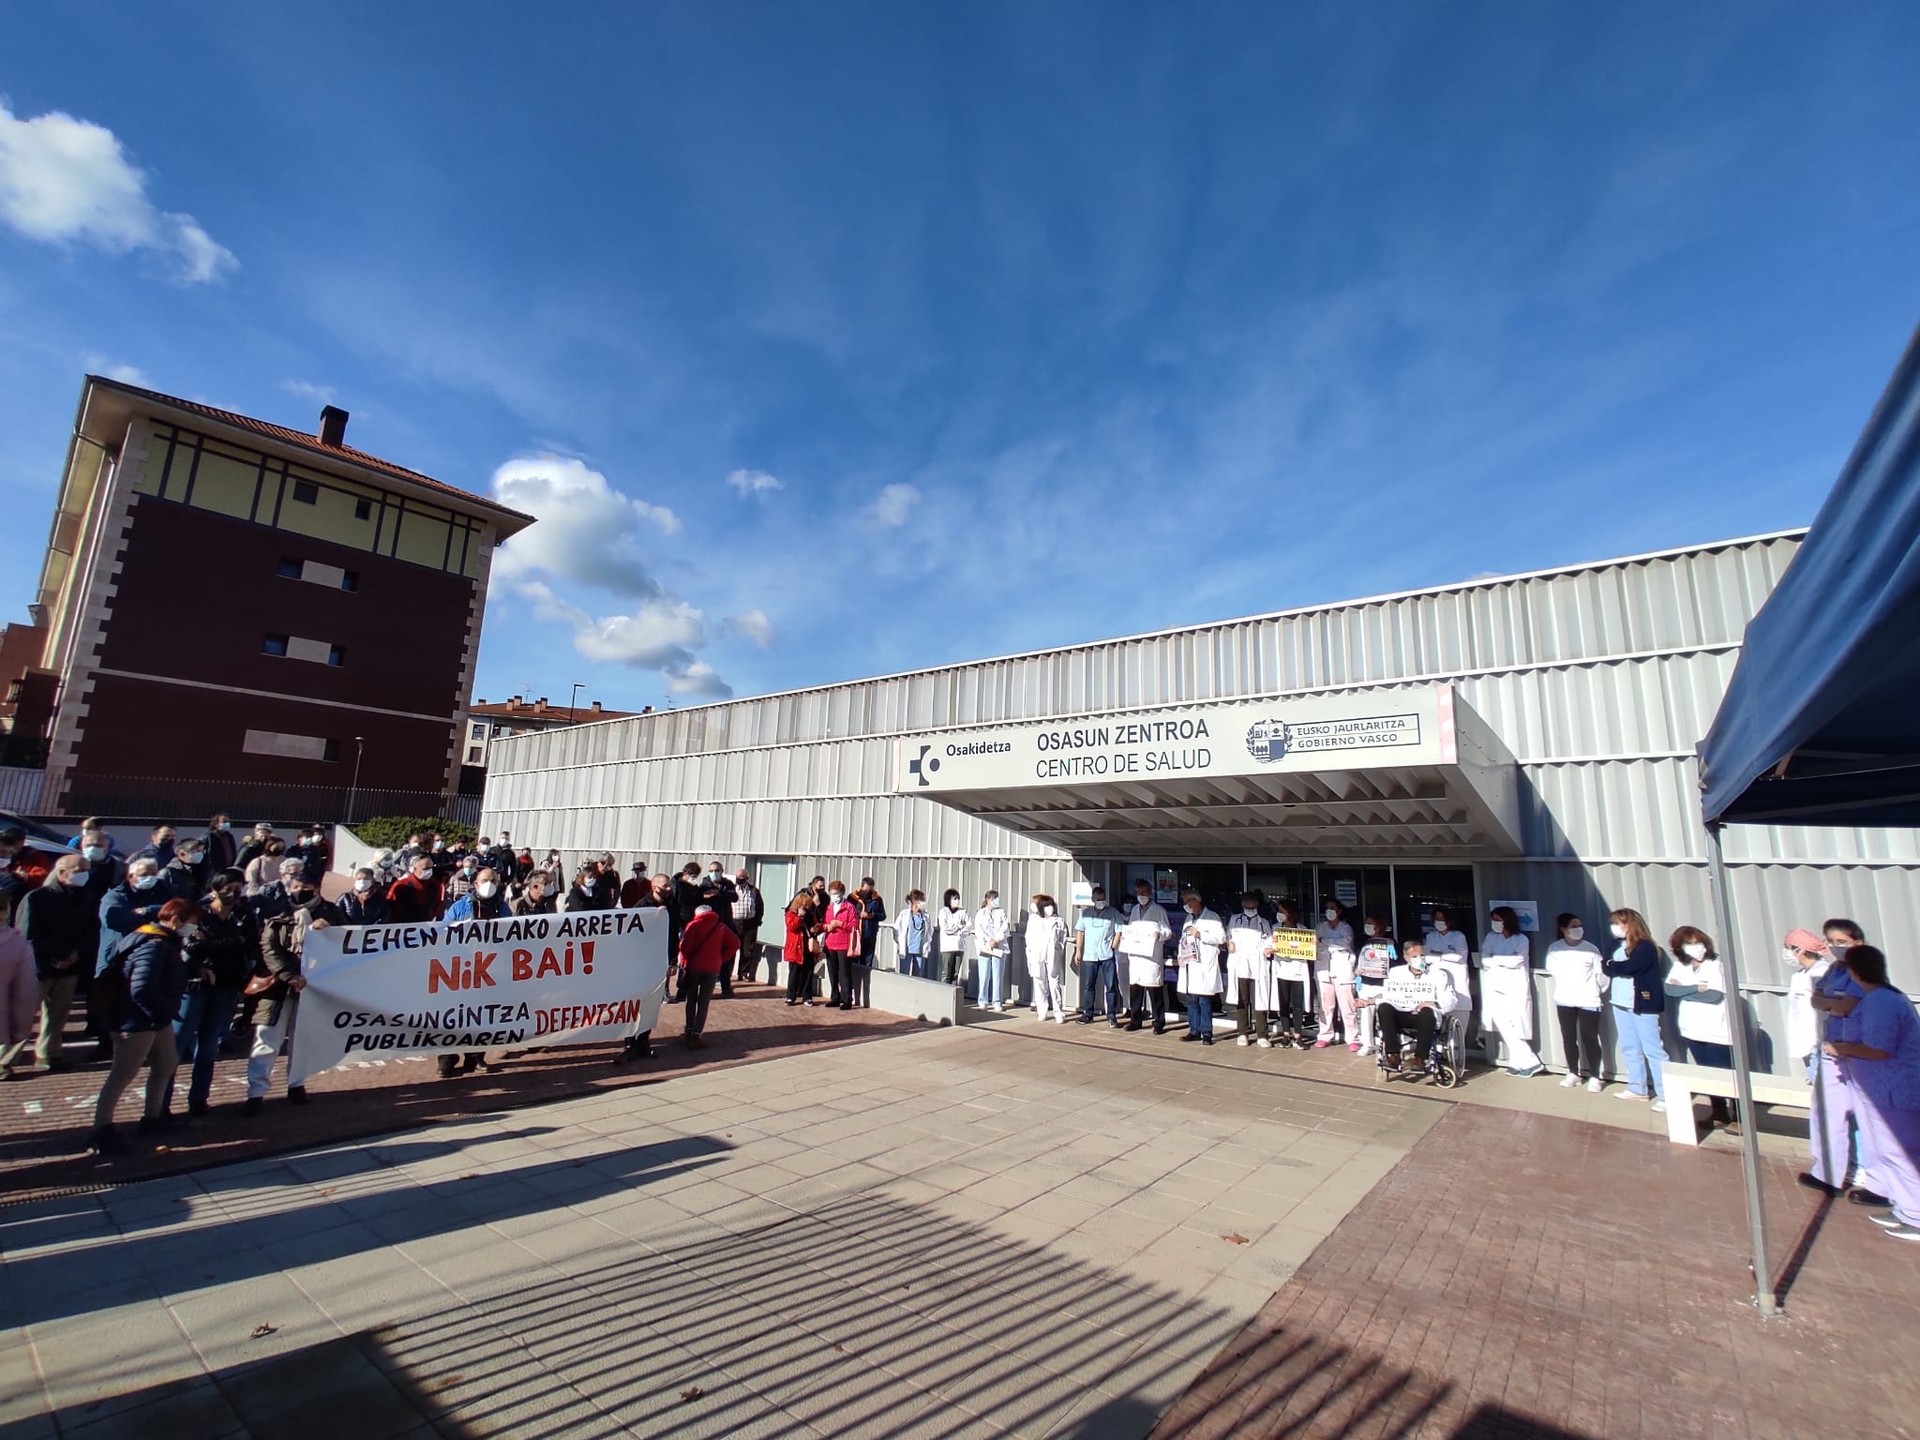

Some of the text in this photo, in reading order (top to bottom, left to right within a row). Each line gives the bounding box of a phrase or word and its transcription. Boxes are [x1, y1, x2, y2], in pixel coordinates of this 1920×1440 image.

[1037, 718, 1210, 751] OSASUN ZENTROA
[1297, 719, 1406, 736] EUSKO JAURLARITZA
[946, 741, 1012, 757] Osakidetza
[1298, 733, 1398, 748] GOBIERNO VASCO
[1036, 748, 1211, 778] CENTRO DE SALUD
[342, 913, 645, 955] LEHEN MAILAKO ARRETA
[1399, 986, 1433, 994] PELIGRO
[534, 999, 641, 1036] DEFENTSAN
